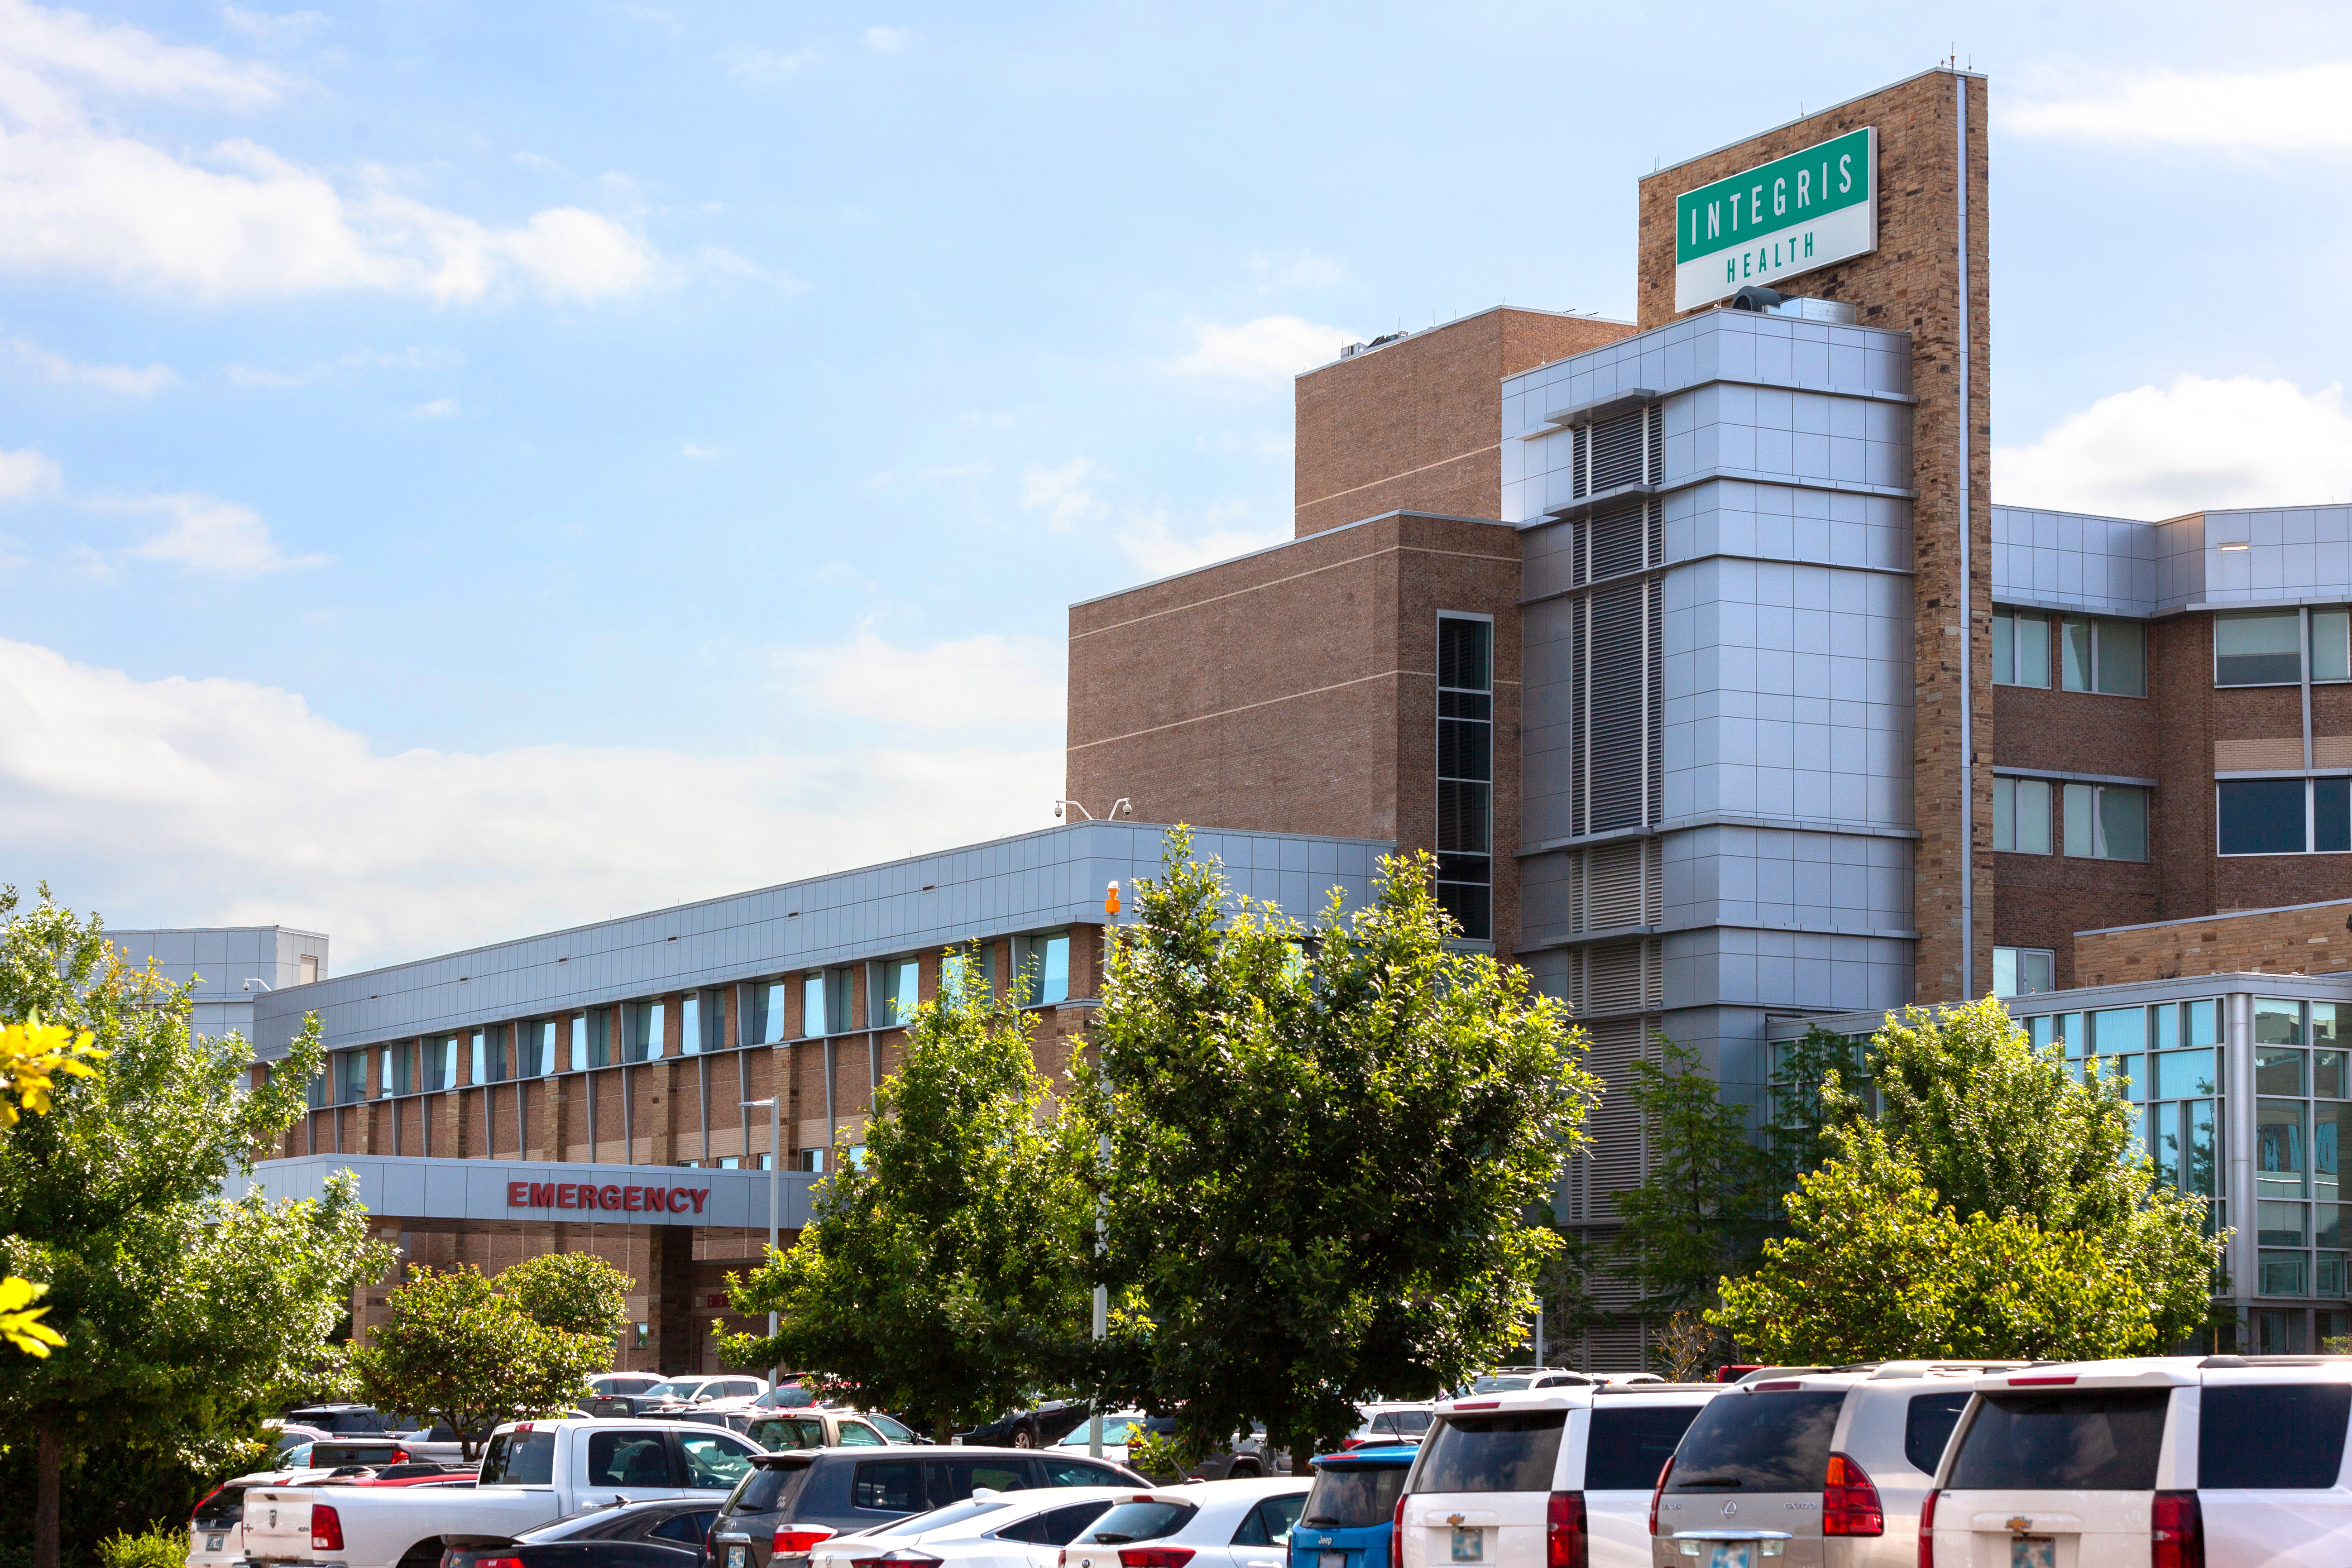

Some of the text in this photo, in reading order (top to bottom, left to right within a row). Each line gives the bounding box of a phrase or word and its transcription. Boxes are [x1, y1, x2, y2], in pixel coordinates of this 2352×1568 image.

[1692, 154, 1851, 245] INTEGRIS
[1727, 231, 1813, 283] HEALTH
[509, 1181, 709, 1213] EMERGENCY
[1318, 1534, 1332, 1546] Jeep
